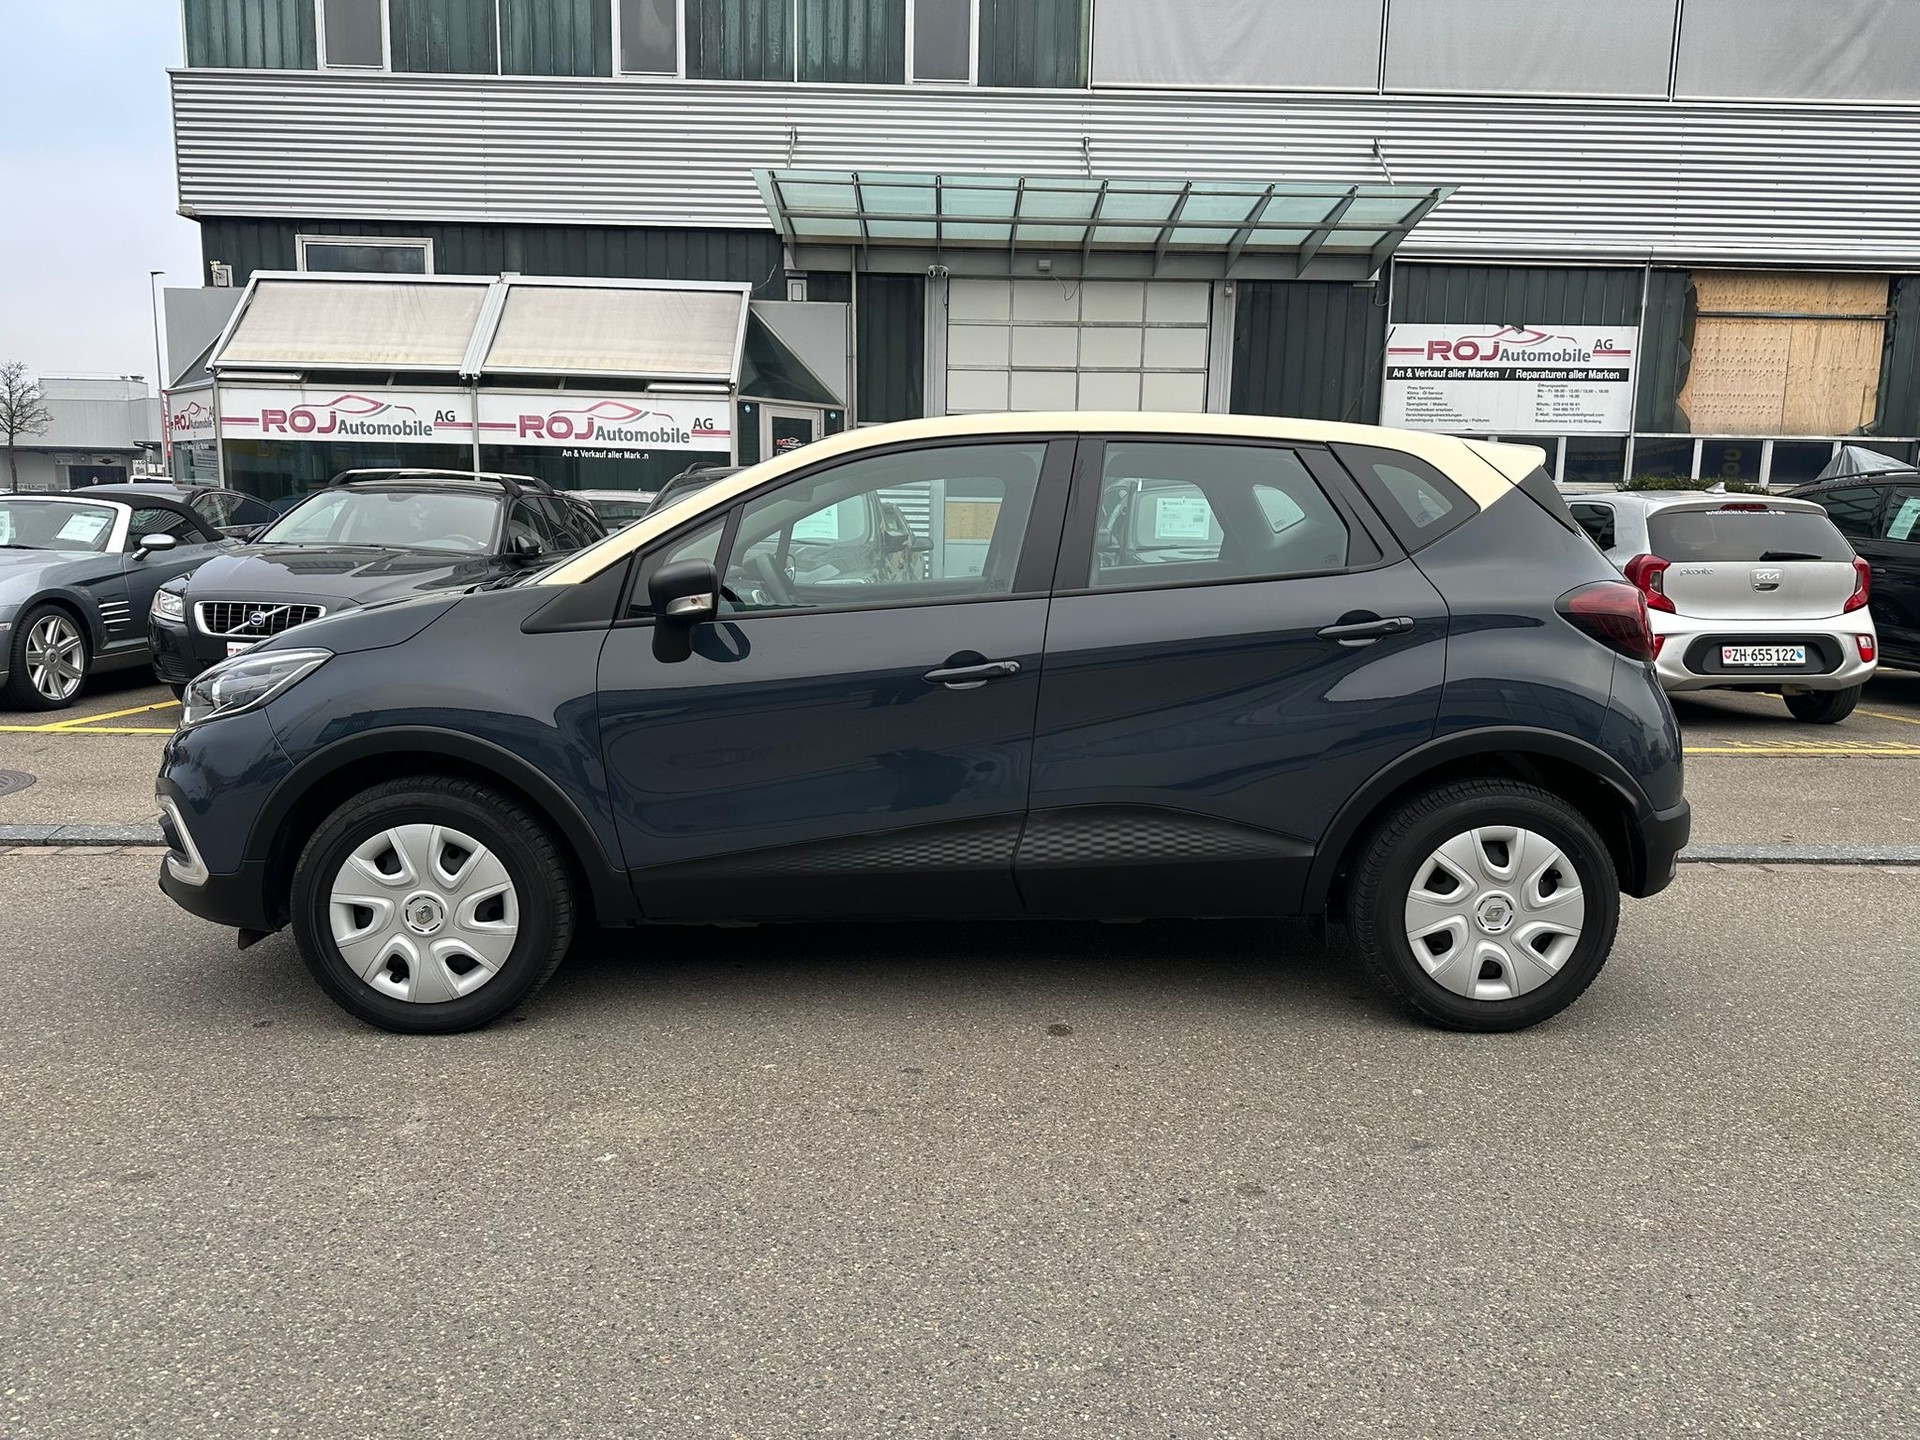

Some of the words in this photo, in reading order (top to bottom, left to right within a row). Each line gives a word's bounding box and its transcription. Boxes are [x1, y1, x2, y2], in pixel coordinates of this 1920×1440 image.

[1427, 340, 1500, 361] ROJ
[1499, 348, 1591, 362] Automobile
[1594, 339, 1613, 350] AG
[1392, 368, 1404, 378] An
[1406, 369, 1413, 378] &
[1414, 369, 1447, 378] Verkauf
[1448, 369, 1466, 378] aller
[1468, 369, 1499, 378] Marken
[1505, 369, 1510, 378] /
[1516, 369, 1567, 380] Reparaturen
[1568, 370, 1587, 379] aller
[1588, 370, 1620, 379] Marken
[174, 414, 191, 431] ROJ
[262, 409, 336, 433] ROJ
[338, 419, 433, 436] Automobile
[434, 410, 456, 422] AG
[519, 415, 594, 439] ROJ
[595, 426, 690, 443] Automobile
[692, 418, 714, 430] AG
[562, 449, 572, 457] An
[580, 450, 607, 458] Verkauf
[623, 451, 649, 459] Markn
[1775, 648, 1796, 661] 122
